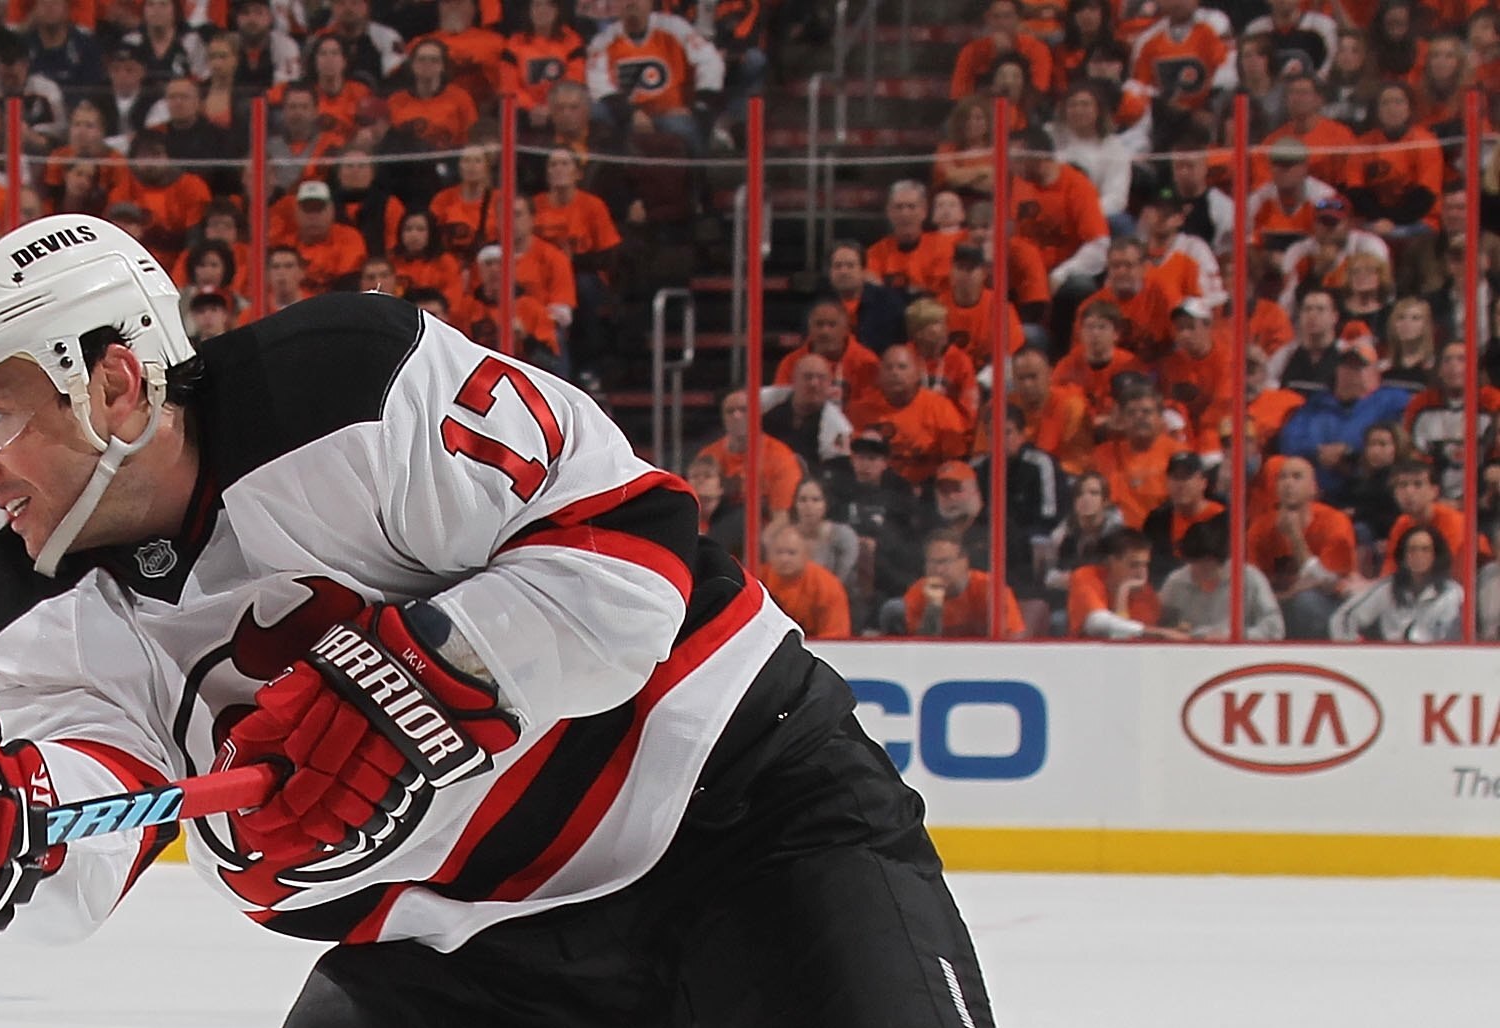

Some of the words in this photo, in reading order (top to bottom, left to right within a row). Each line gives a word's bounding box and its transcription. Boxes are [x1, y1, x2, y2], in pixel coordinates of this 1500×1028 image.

[10, 225, 98, 269] DEVILS
[440, 355, 565, 504] 17
[311, 624, 465, 766] ARRIOR
[1221, 691, 1348, 746] KIA
